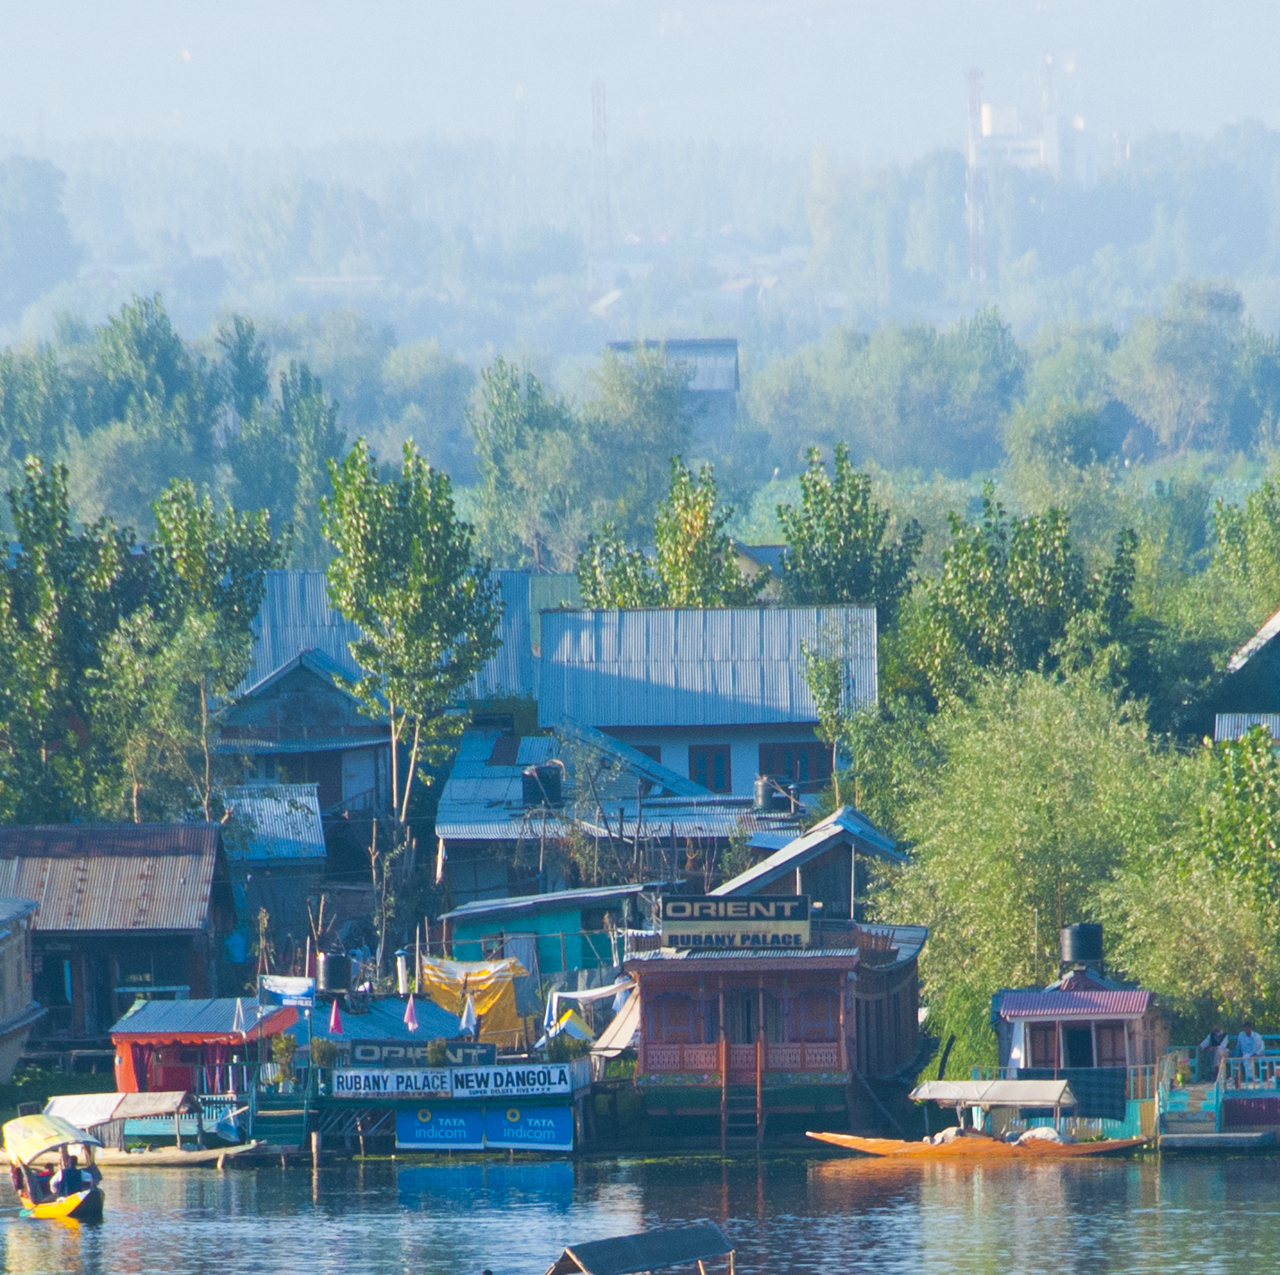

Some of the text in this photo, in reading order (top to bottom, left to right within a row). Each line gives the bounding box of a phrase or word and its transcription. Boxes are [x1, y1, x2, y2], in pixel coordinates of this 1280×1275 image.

[666, 902, 799, 918] ORIENT
[668, 934, 802, 946] RUBANY PALACE
[336, 1074, 448, 1091] RUBANY PALACE
[454, 1068, 568, 1090] NEW DANGOLA
[438, 1118, 465, 1127] TATA
[526, 1118, 554, 1127] TATA
[415, 1127, 466, 1139] indicom
[503, 1127, 555, 1140] indicom
